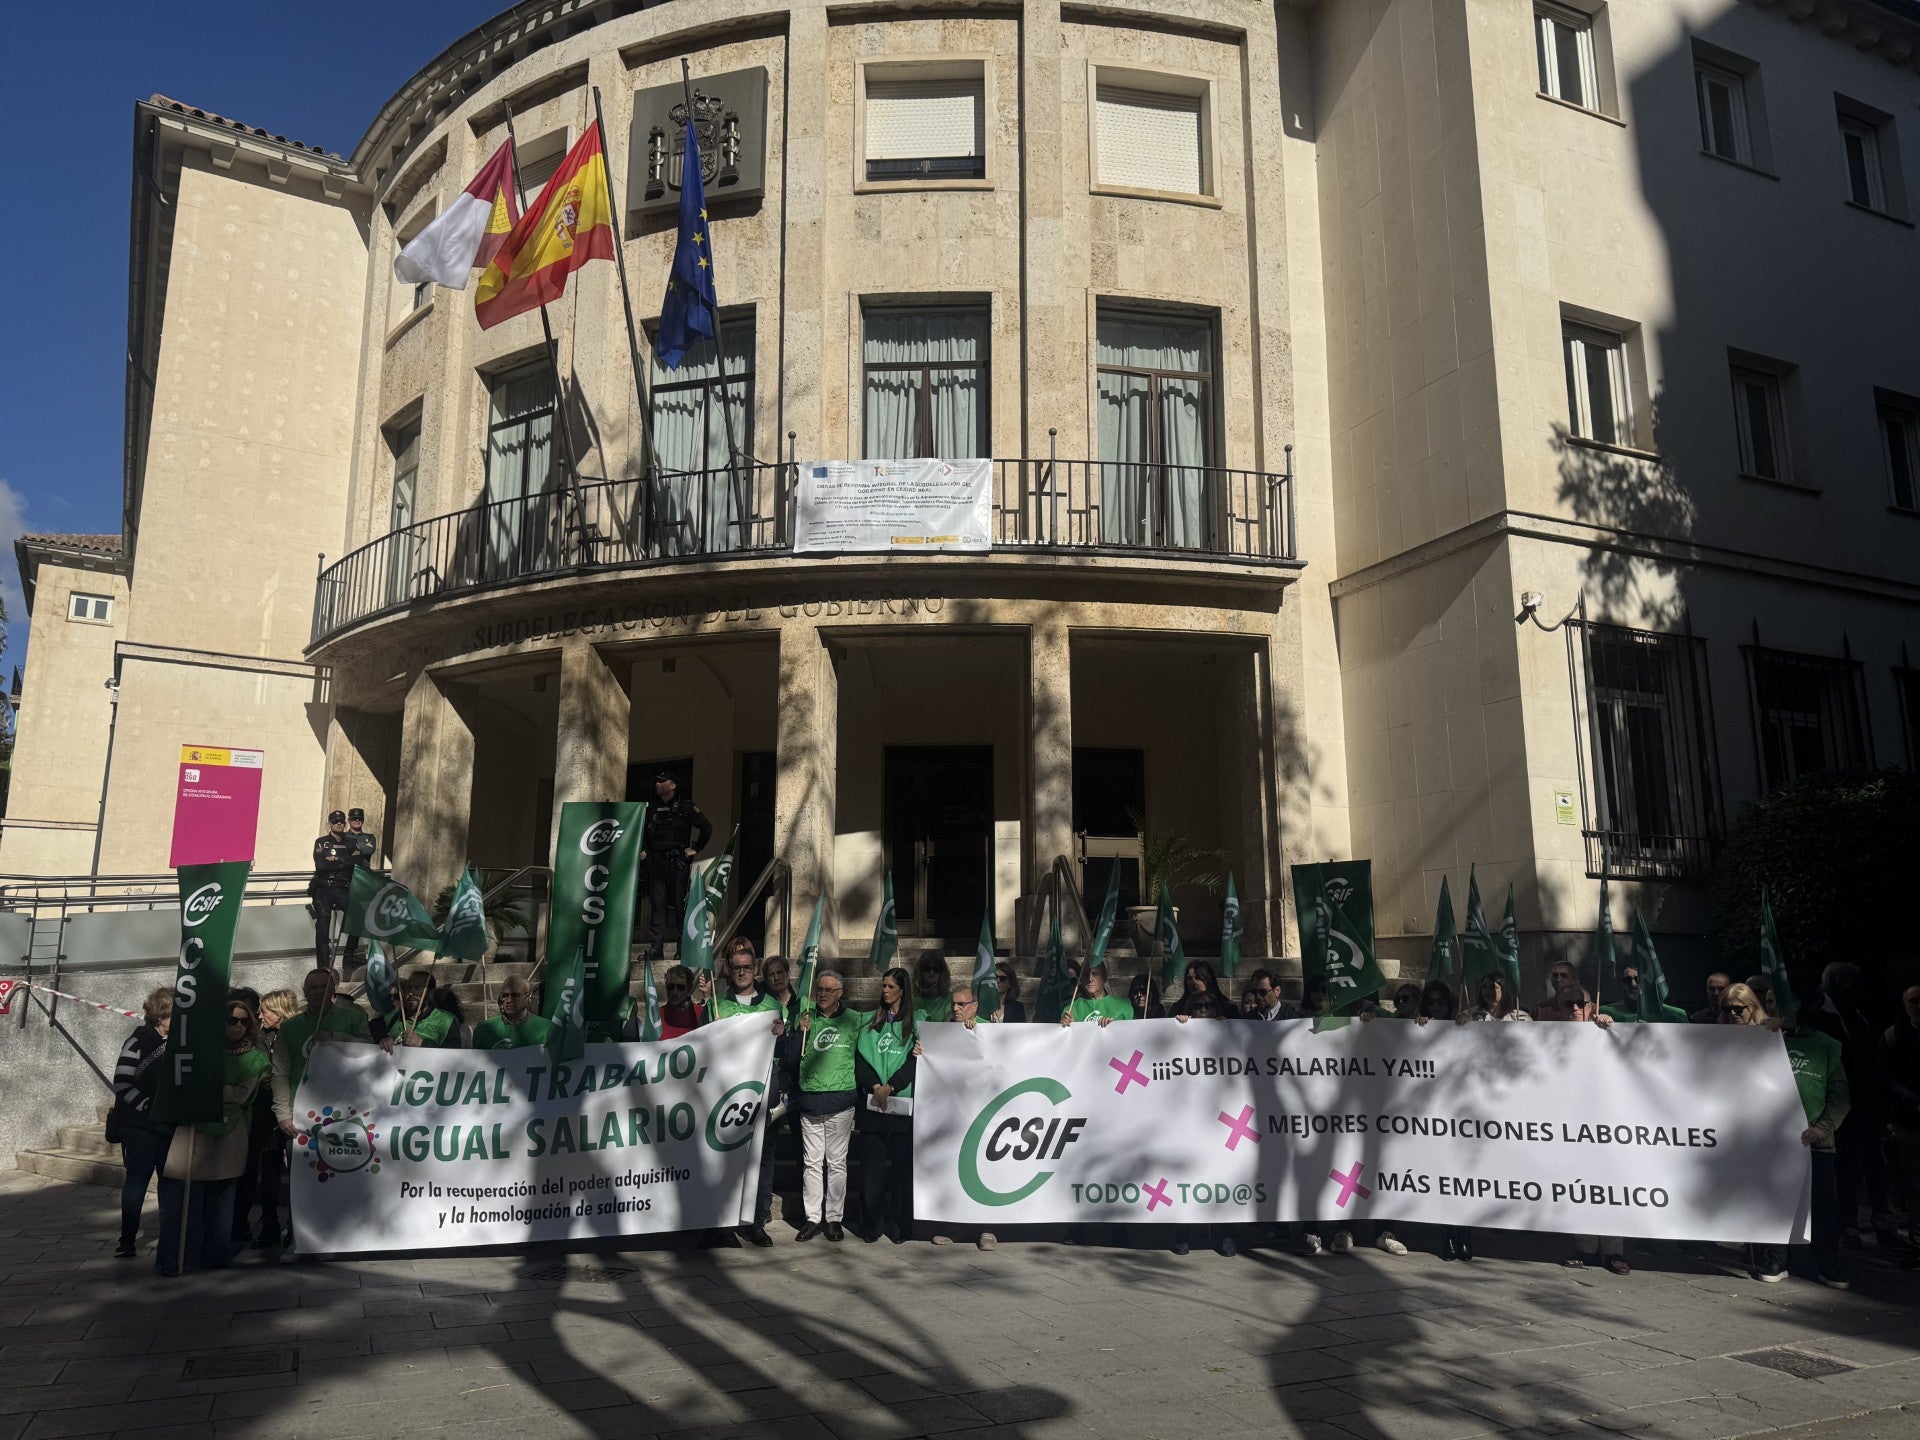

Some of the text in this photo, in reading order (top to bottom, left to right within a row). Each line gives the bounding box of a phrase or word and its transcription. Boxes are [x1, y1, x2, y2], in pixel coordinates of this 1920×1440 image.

[473, 587, 946, 649] SUBDELEGACION DEL GOBIERNO
[174, 937, 204, 1086] CSIF
[389, 1044, 708, 1107] IGUAL TRABAJO,
[1152, 1056, 1436, 1081] ¡¡¡SUBIDA SALARIAL YA!!!
[325, 1132, 359, 1149] 35
[389, 1101, 696, 1163] IGUAL SALARIO
[985, 1116, 1088, 1162] CSIF
[1268, 1114, 1718, 1149] MEJORES CONDICIONES LABORALES
[328, 1147, 363, 1156] HORAS
[400, 1165, 691, 1201] Por la recuperación del poder adquisitivo
[1071, 1182, 1141, 1205] TODO
[1176, 1182, 1267, 1206] TOD@S
[1377, 1168, 1670, 1208] MÁS EMPLEO PÚBLICO
[437, 1195, 652, 1229] y la homologación de salarios
